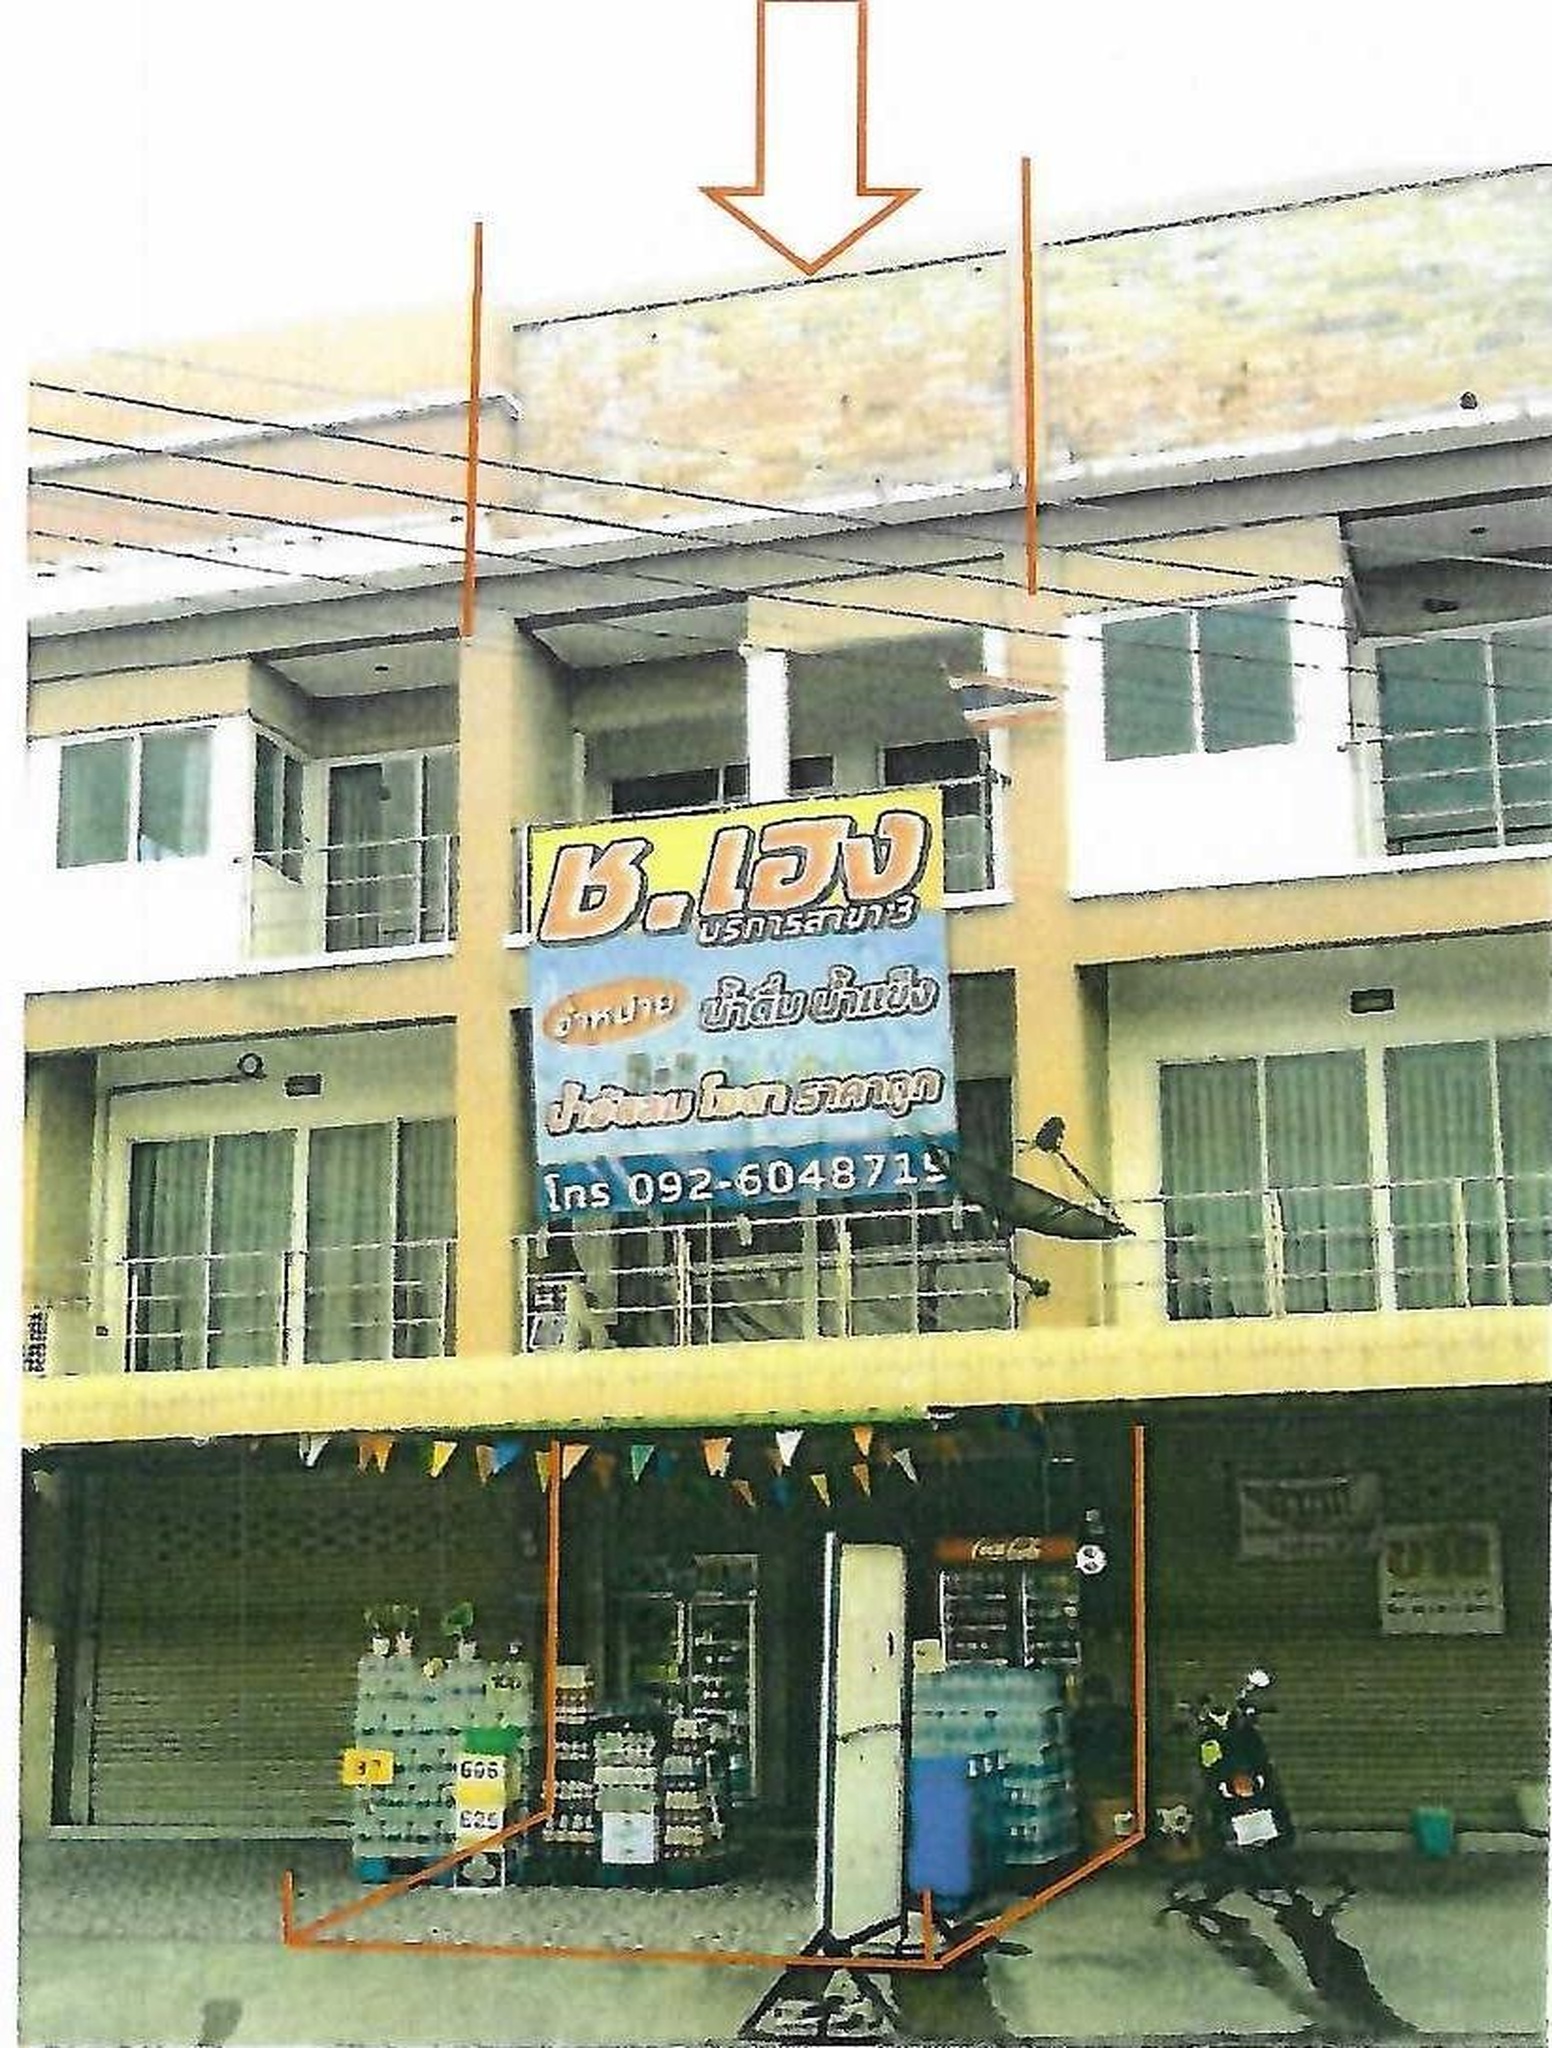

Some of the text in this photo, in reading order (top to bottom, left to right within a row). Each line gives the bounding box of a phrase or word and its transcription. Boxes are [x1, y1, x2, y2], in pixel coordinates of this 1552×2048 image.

[701, 970, 808, 1032] น้ำดื่ม
[794, 1067, 946, 1119] ราคาถูก
